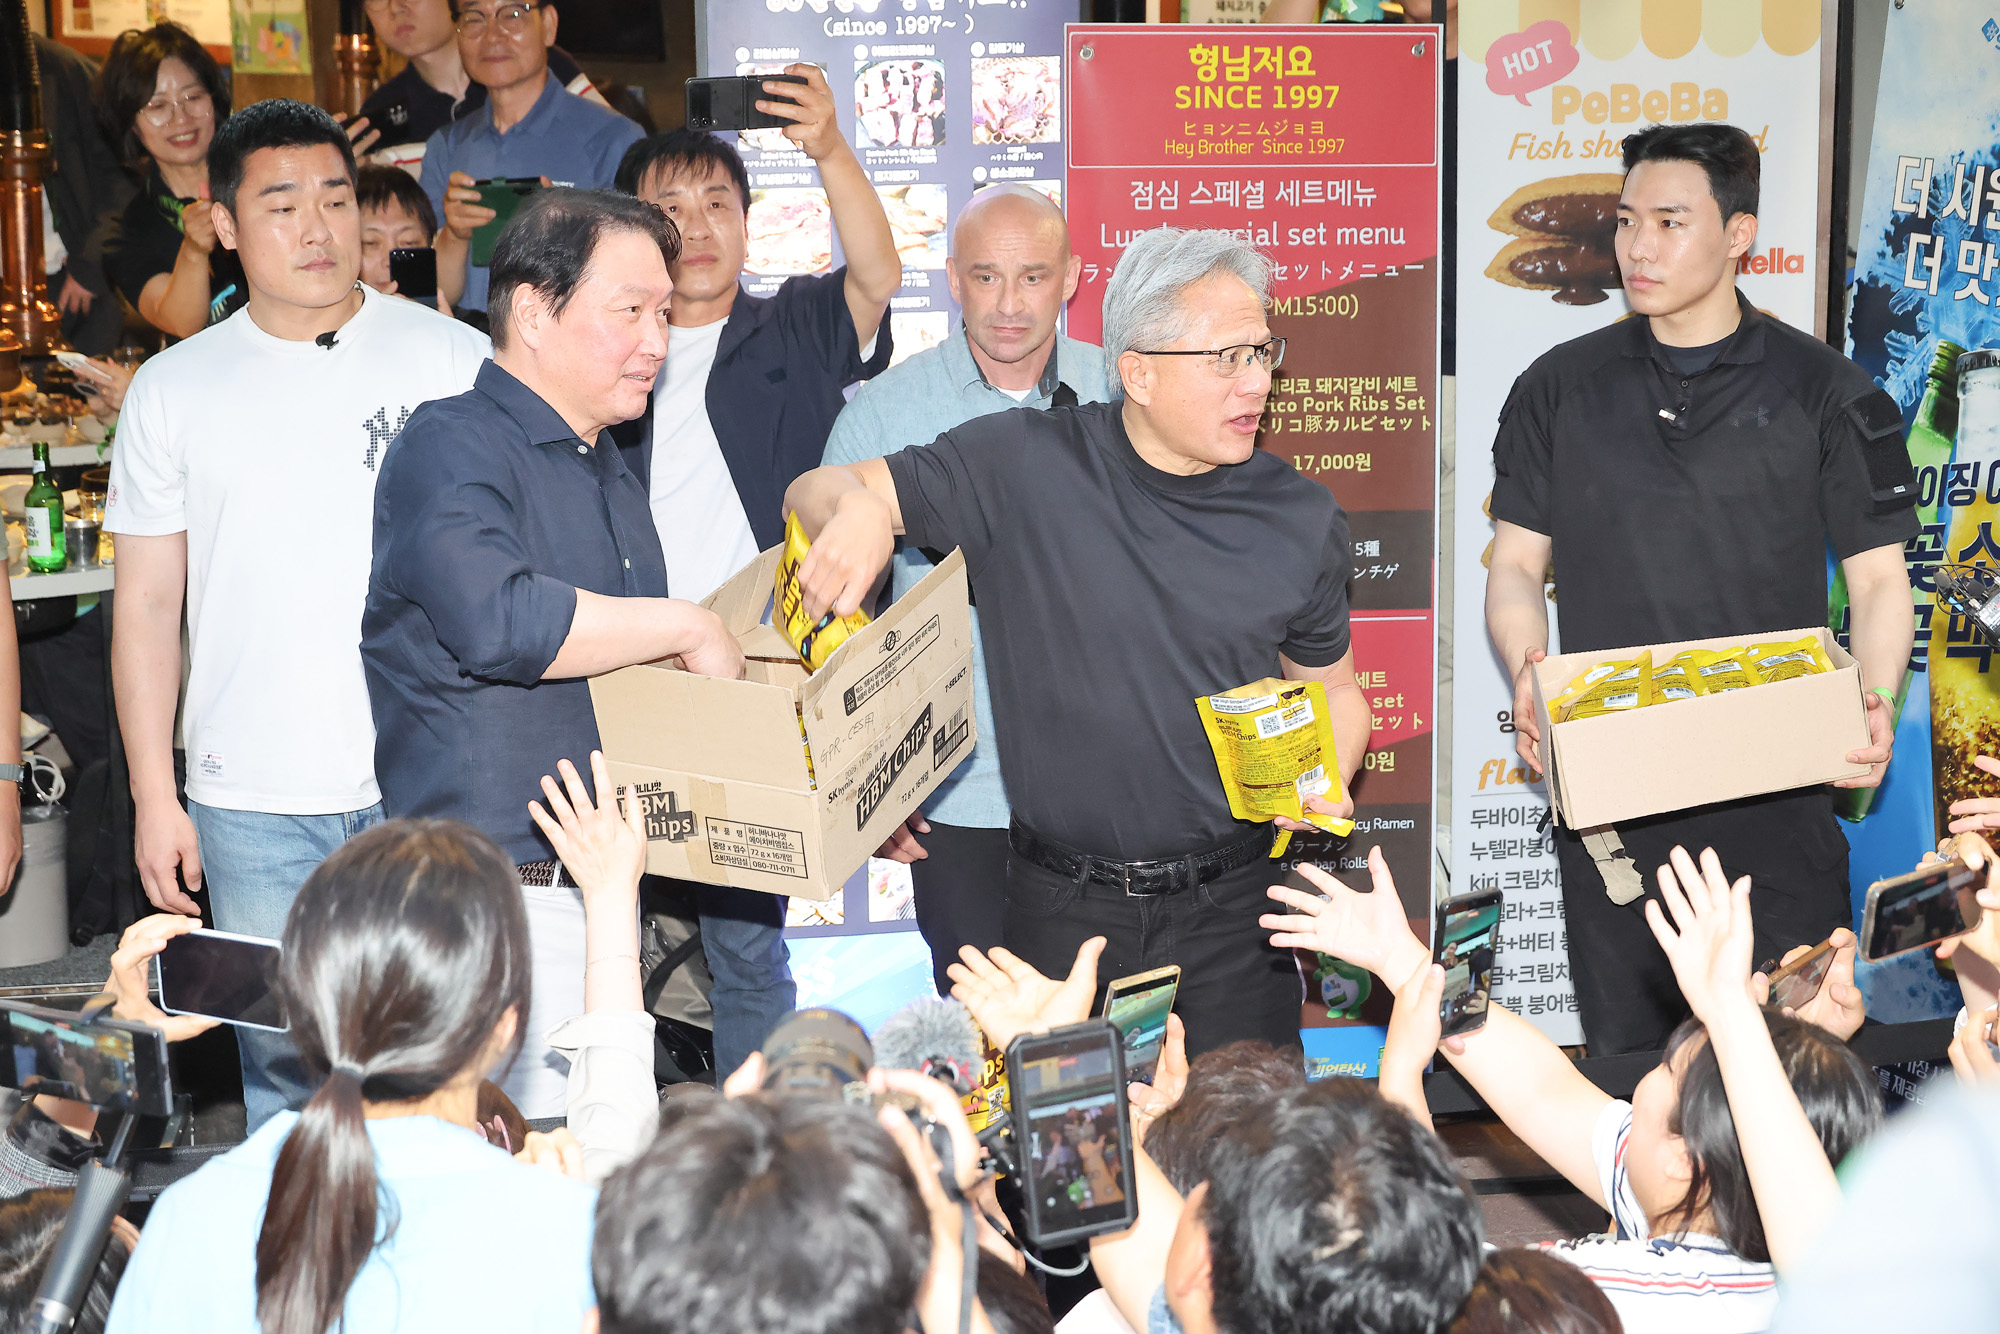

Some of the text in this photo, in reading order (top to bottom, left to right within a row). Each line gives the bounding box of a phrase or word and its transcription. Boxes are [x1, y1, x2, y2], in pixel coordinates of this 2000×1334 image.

[823, 17, 888, 37] (since
[1188, 43, 1316, 82] 형님저요
[1502, 39, 1553, 79] HOT
[1175, 85, 1340, 109] SINCE 1997
[1551, 82, 1729, 125] PeBeBa
[1164, 138, 1345, 158] Hey Brother Since 1997
[1508, 131, 1574, 160] Fish
[1130, 179, 1378, 210] 점심 스페셜 세트메뉴
[1893, 155, 1934, 219] 더
[1290, 222, 1327, 245] set
[1336, 226, 1406, 245] menu
[1903, 232, 2000, 308] 더 맛
[1315, 376, 1381, 395] 돼지갈비
[1385, 376, 1418, 393] 세트
[1303, 396, 1344, 412] Pork
[1349, 395, 1389, 412] Ribs
[1395, 395, 1426, 411] Set
[1293, 453, 1372, 475] 17,000원
[1913, 461, 1981, 508] 이징
[1355, 671, 1388, 690] 세트
[1372, 693, 1405, 708] set
[1371, 712, 1424, 730] セット
[1236, 731, 1257, 742] Chips
[859, 713, 930, 825] HBM Chips
[828, 777, 854, 804] SK hynix
[646, 816, 692, 840] hips
[1353, 817, 1415, 833] icy Ramen
[1470, 805, 1553, 829] 두바이초
[748, 827, 787, 840] 허니바나나맛
[750, 848, 759, 856] 72
[1287, 839, 1348, 853] ラーメン
[752, 861, 796, 874] 080-711-0711
[1290, 858, 1337, 873] Gbap
[1340, 857, 1368, 869] Rolls
[1470, 868, 1562, 891] kiri 크림치
